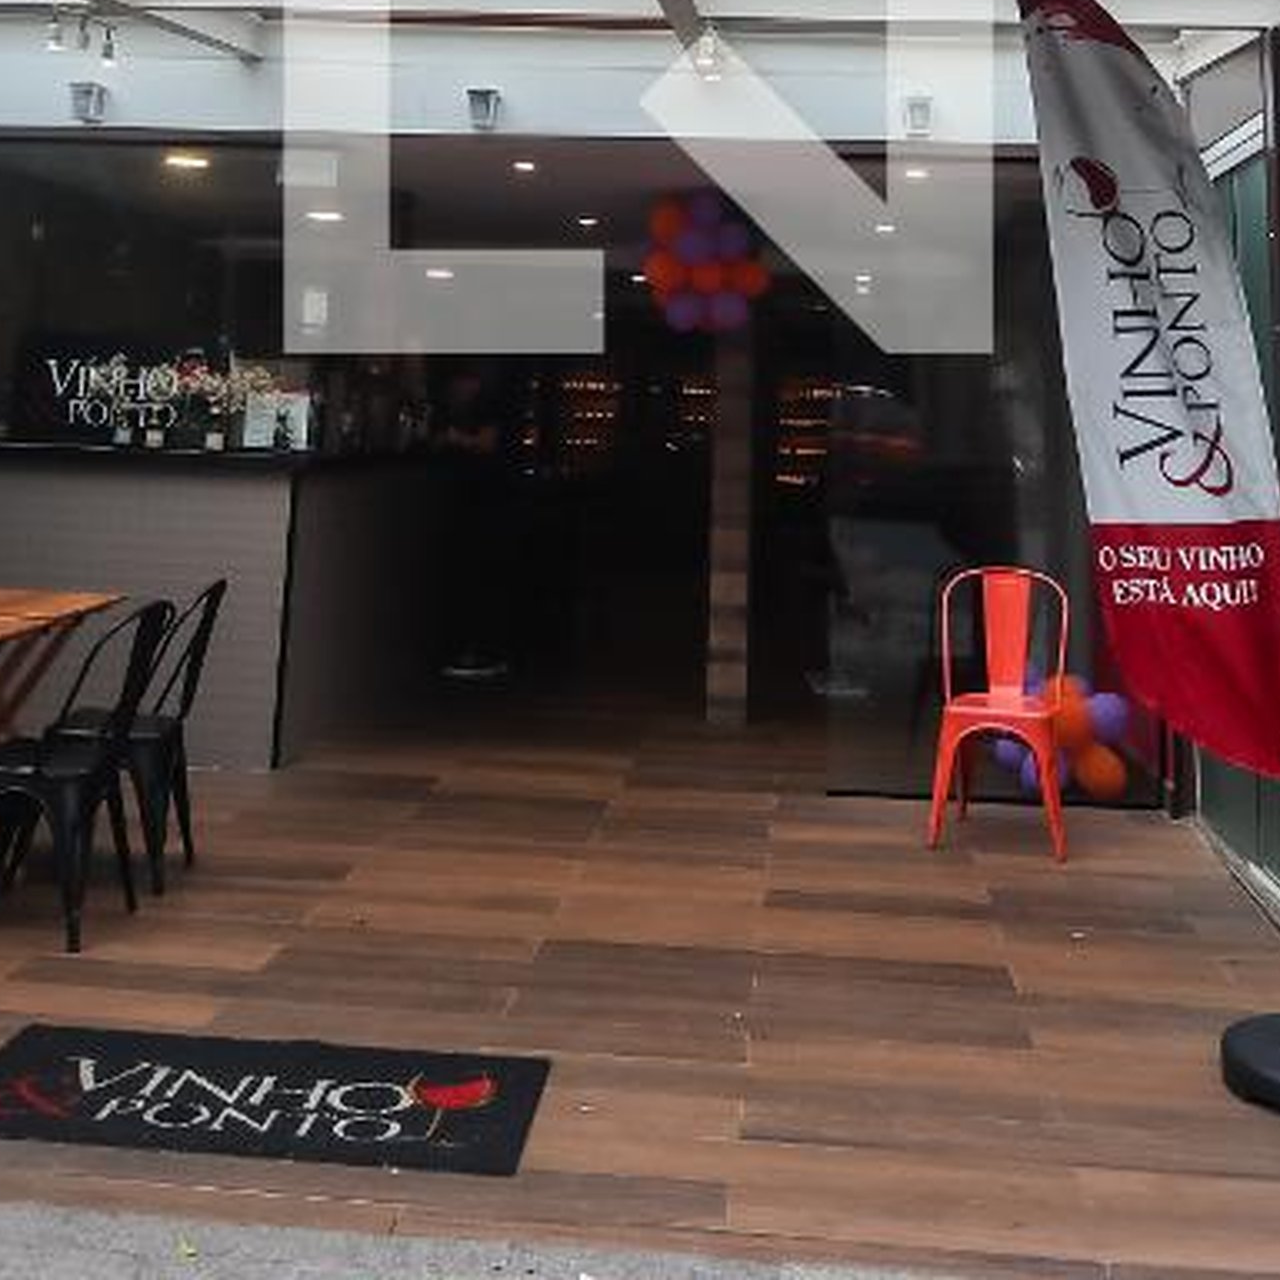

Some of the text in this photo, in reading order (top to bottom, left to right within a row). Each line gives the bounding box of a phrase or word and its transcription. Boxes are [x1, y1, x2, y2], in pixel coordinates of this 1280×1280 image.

[1103, 212, 1186, 471] VINHO
[1150, 210, 1234, 497] & PONTO
[1098, 543, 1265, 571] O SEU VINHO
[1112, 576, 1259, 611] ESTÁ AQUI!
[66, 1055, 414, 1115] VINHO
[94, 1097, 402, 1142] PONTO
